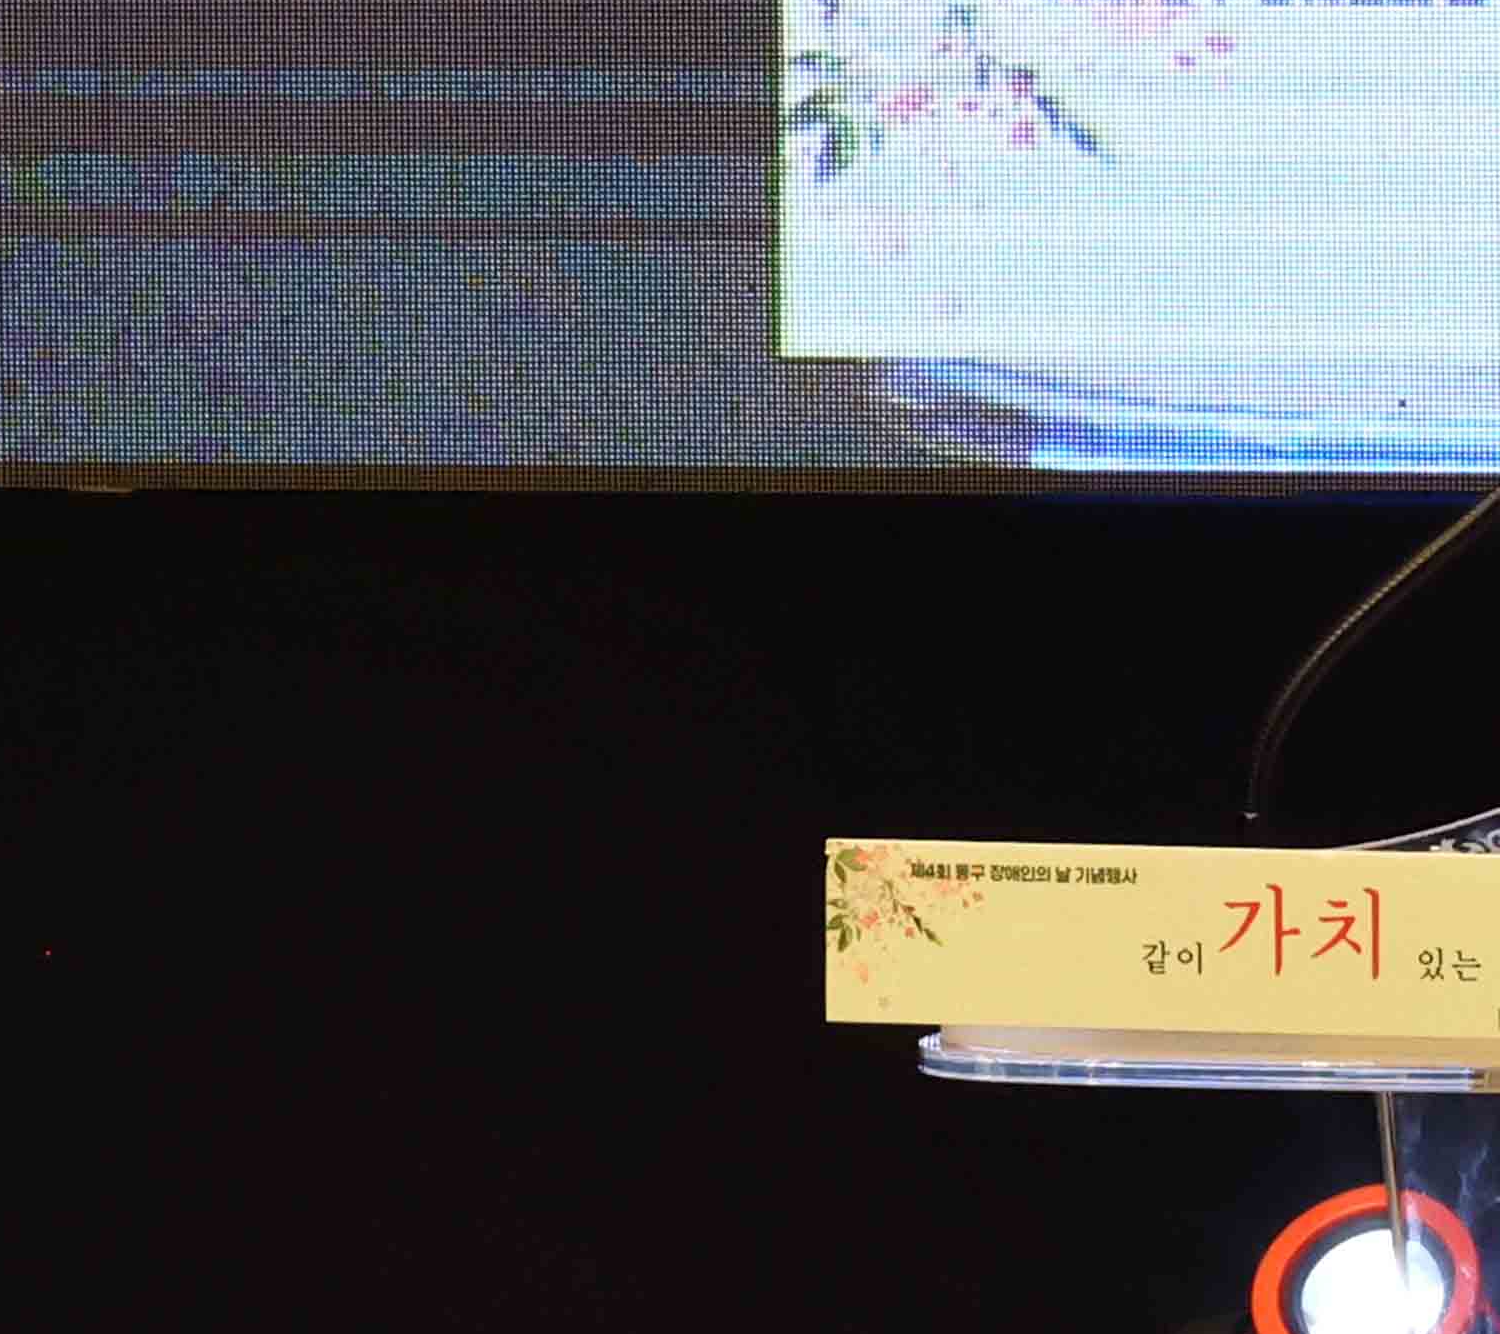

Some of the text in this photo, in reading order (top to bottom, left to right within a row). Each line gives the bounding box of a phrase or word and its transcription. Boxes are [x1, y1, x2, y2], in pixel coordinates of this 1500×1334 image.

[990, 865, 1050, 882] 장애인의
[1056, 866, 1070, 884] 날
[1142, 940, 1202, 975] 같이
[1218, 883, 1380, 980] 가치
[1418, 946, 1481, 982] 있는
